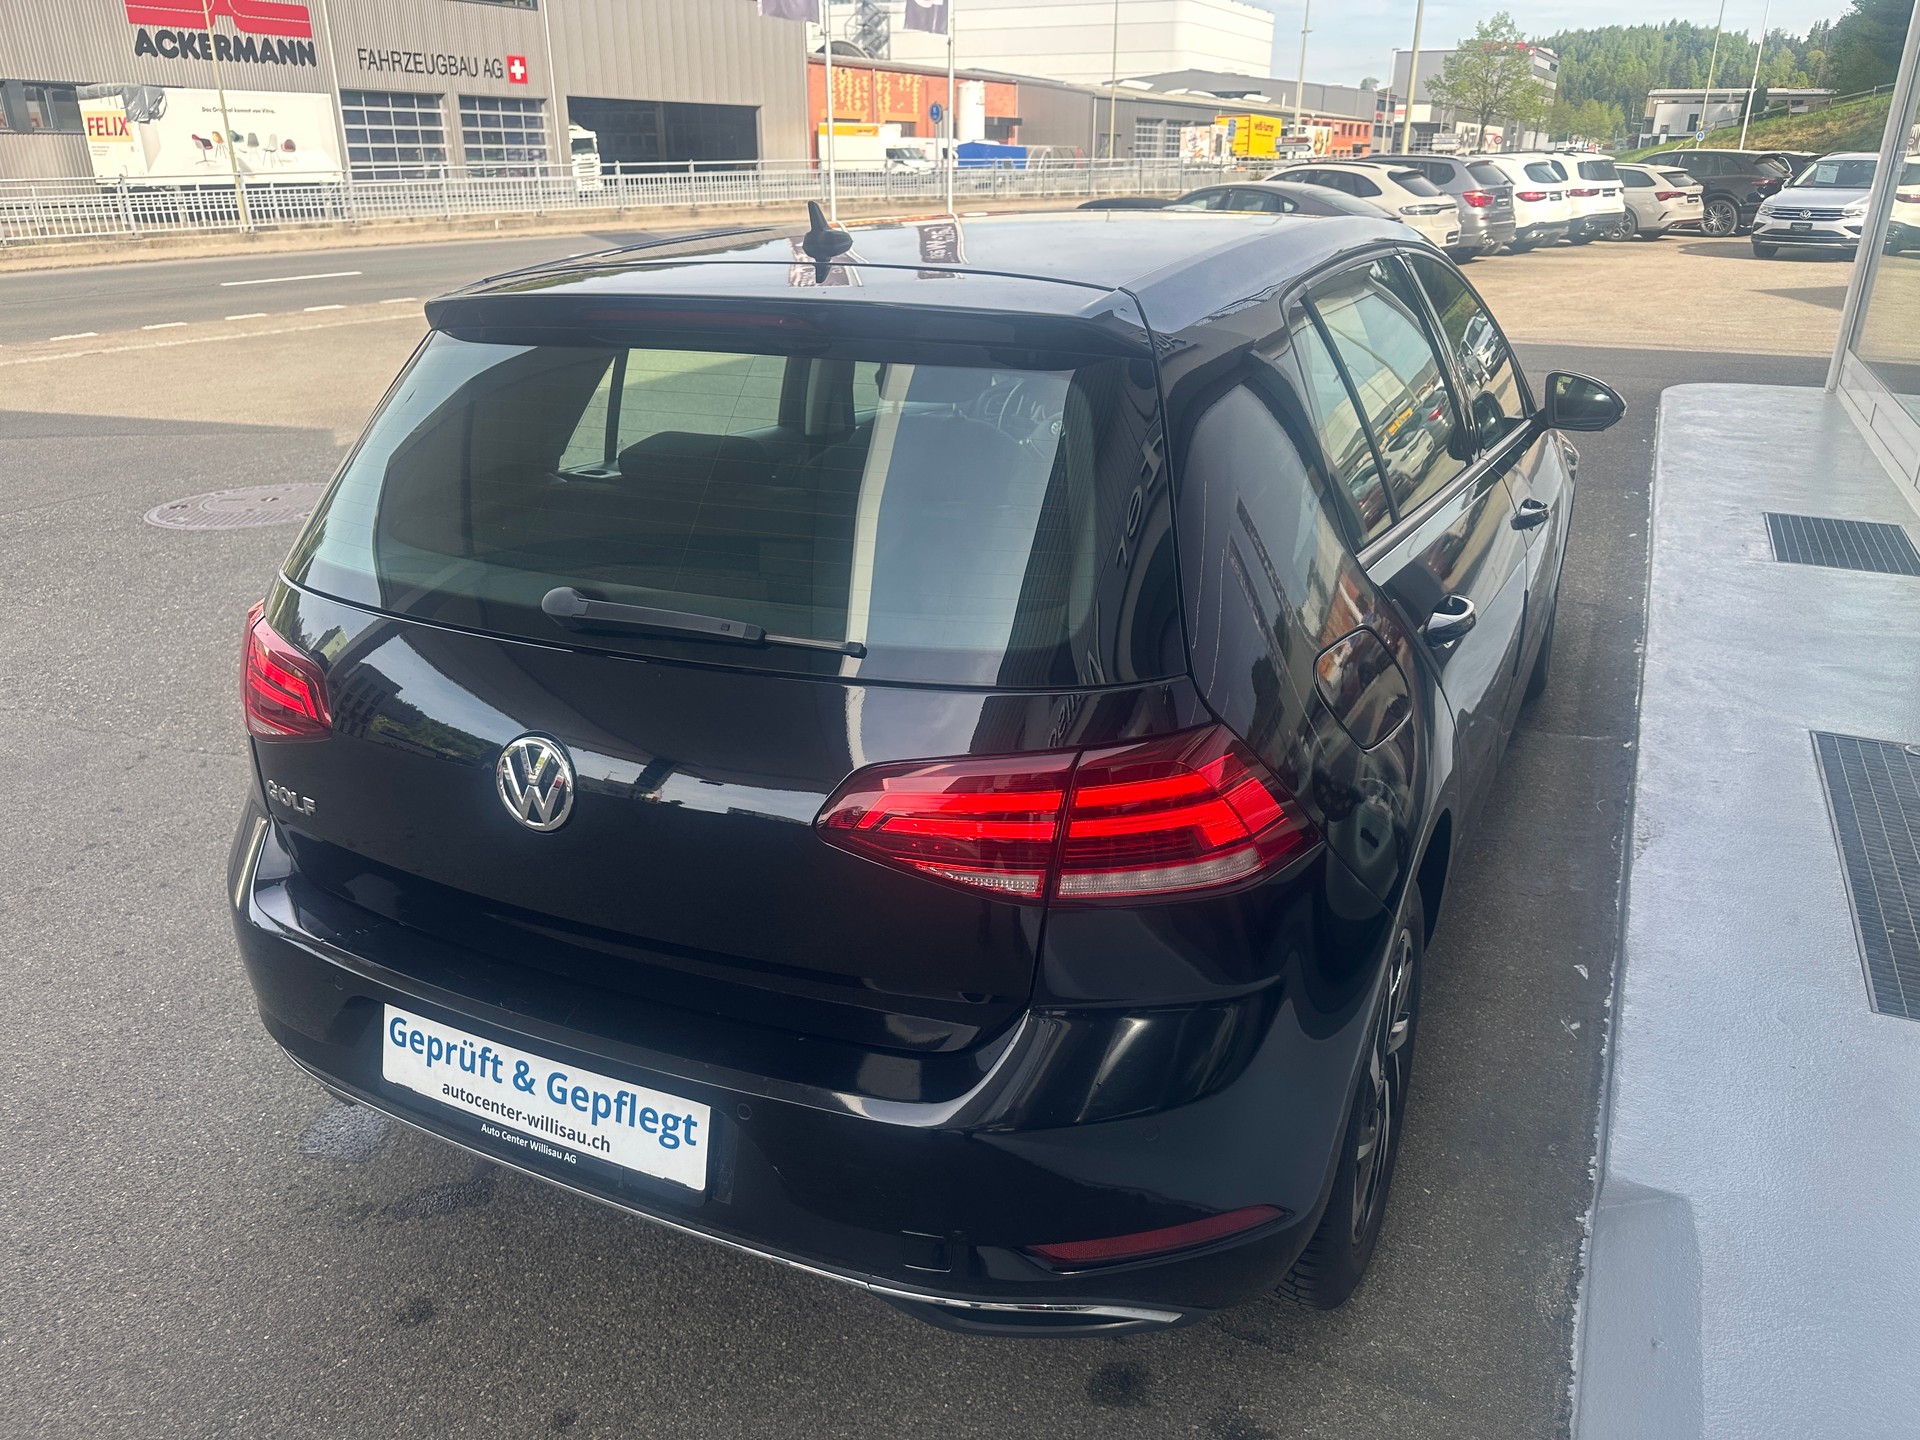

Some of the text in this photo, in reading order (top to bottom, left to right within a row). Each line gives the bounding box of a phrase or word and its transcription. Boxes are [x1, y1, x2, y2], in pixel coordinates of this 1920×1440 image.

[135, 28, 316, 67] ACKERMANN
[357, 48, 504, 79] FAHRZEUGBAU AG
[87, 116, 130, 136] FELIX
[266, 779, 317, 816] GOLF
[389, 1016, 698, 1149] Geprüft & Gepflegt
[442, 1083, 611, 1153] autocenter-willisau.ch
[481, 1123, 577, 1165] Auto Center Willisau AG
